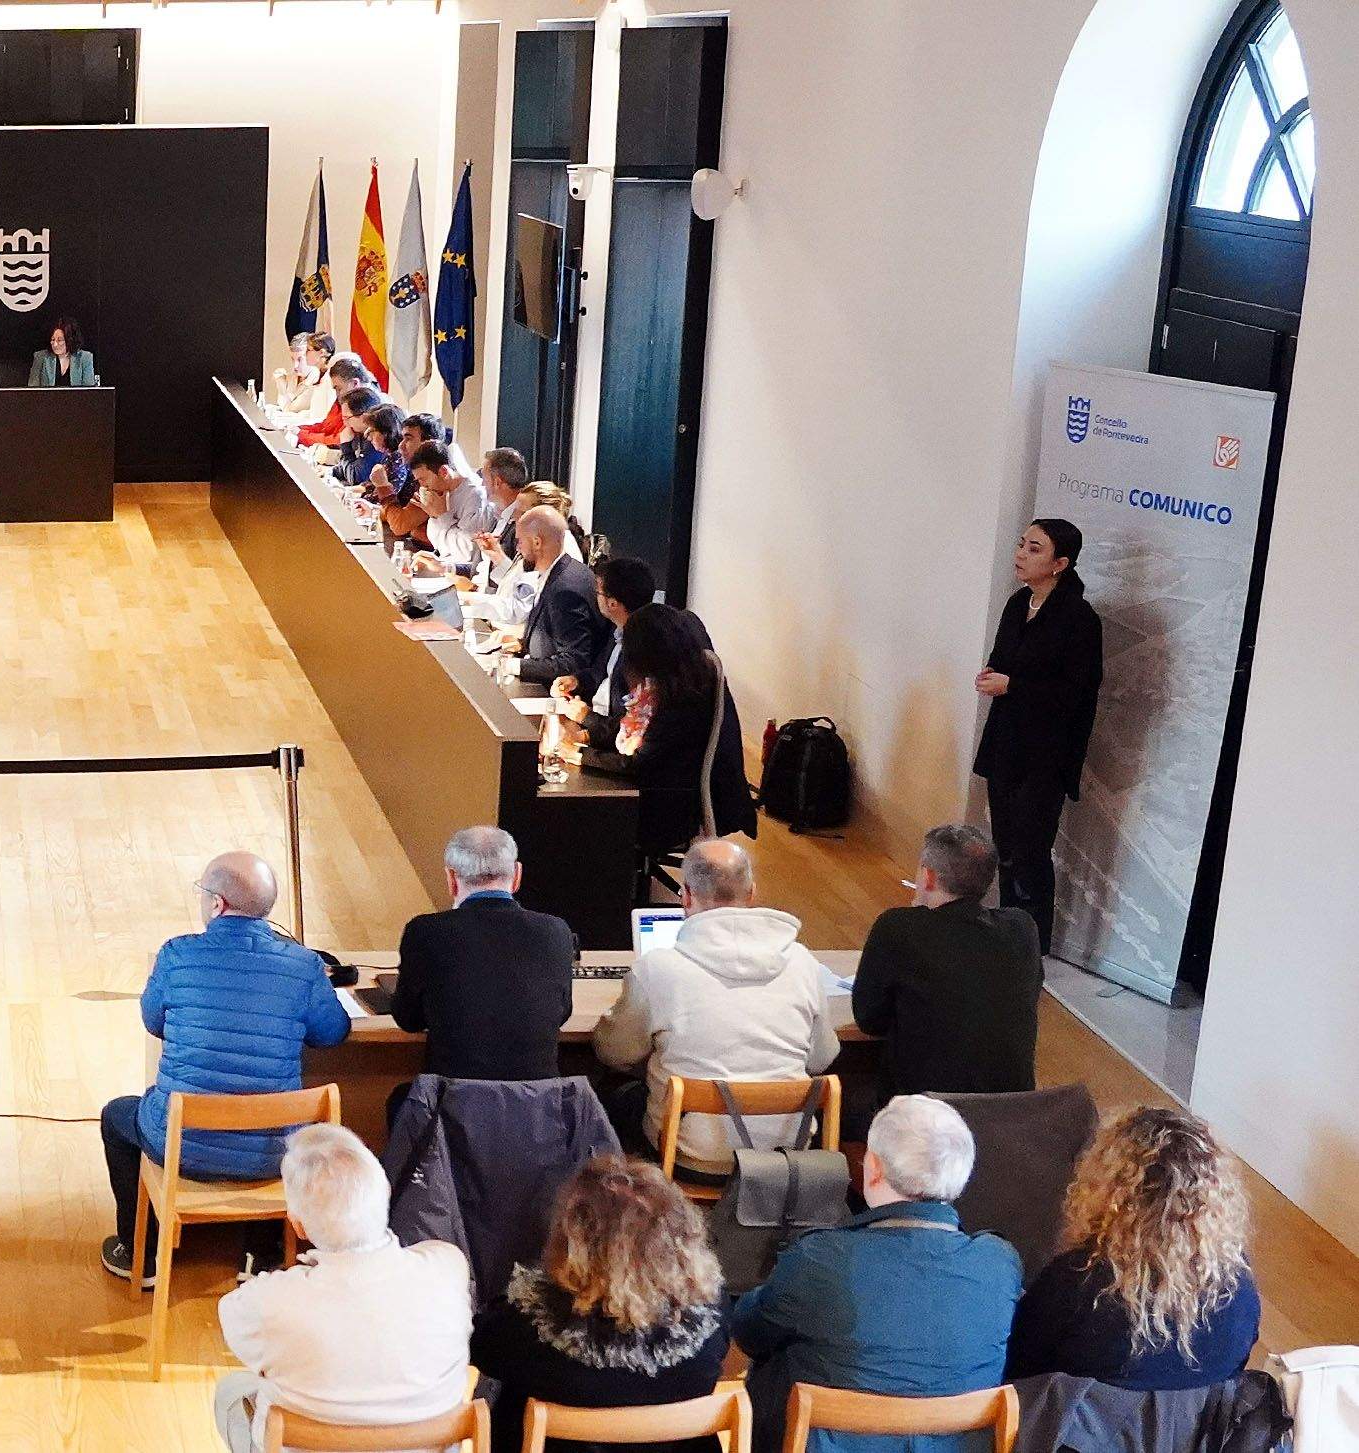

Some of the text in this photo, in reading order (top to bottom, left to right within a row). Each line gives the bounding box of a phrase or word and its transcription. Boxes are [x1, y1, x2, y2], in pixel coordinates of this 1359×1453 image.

[1094, 414, 1128, 429] Concello
[1092, 426, 1149, 445] de Pontevedra
[1058, 472, 1232, 525] Programa COMUNICO
